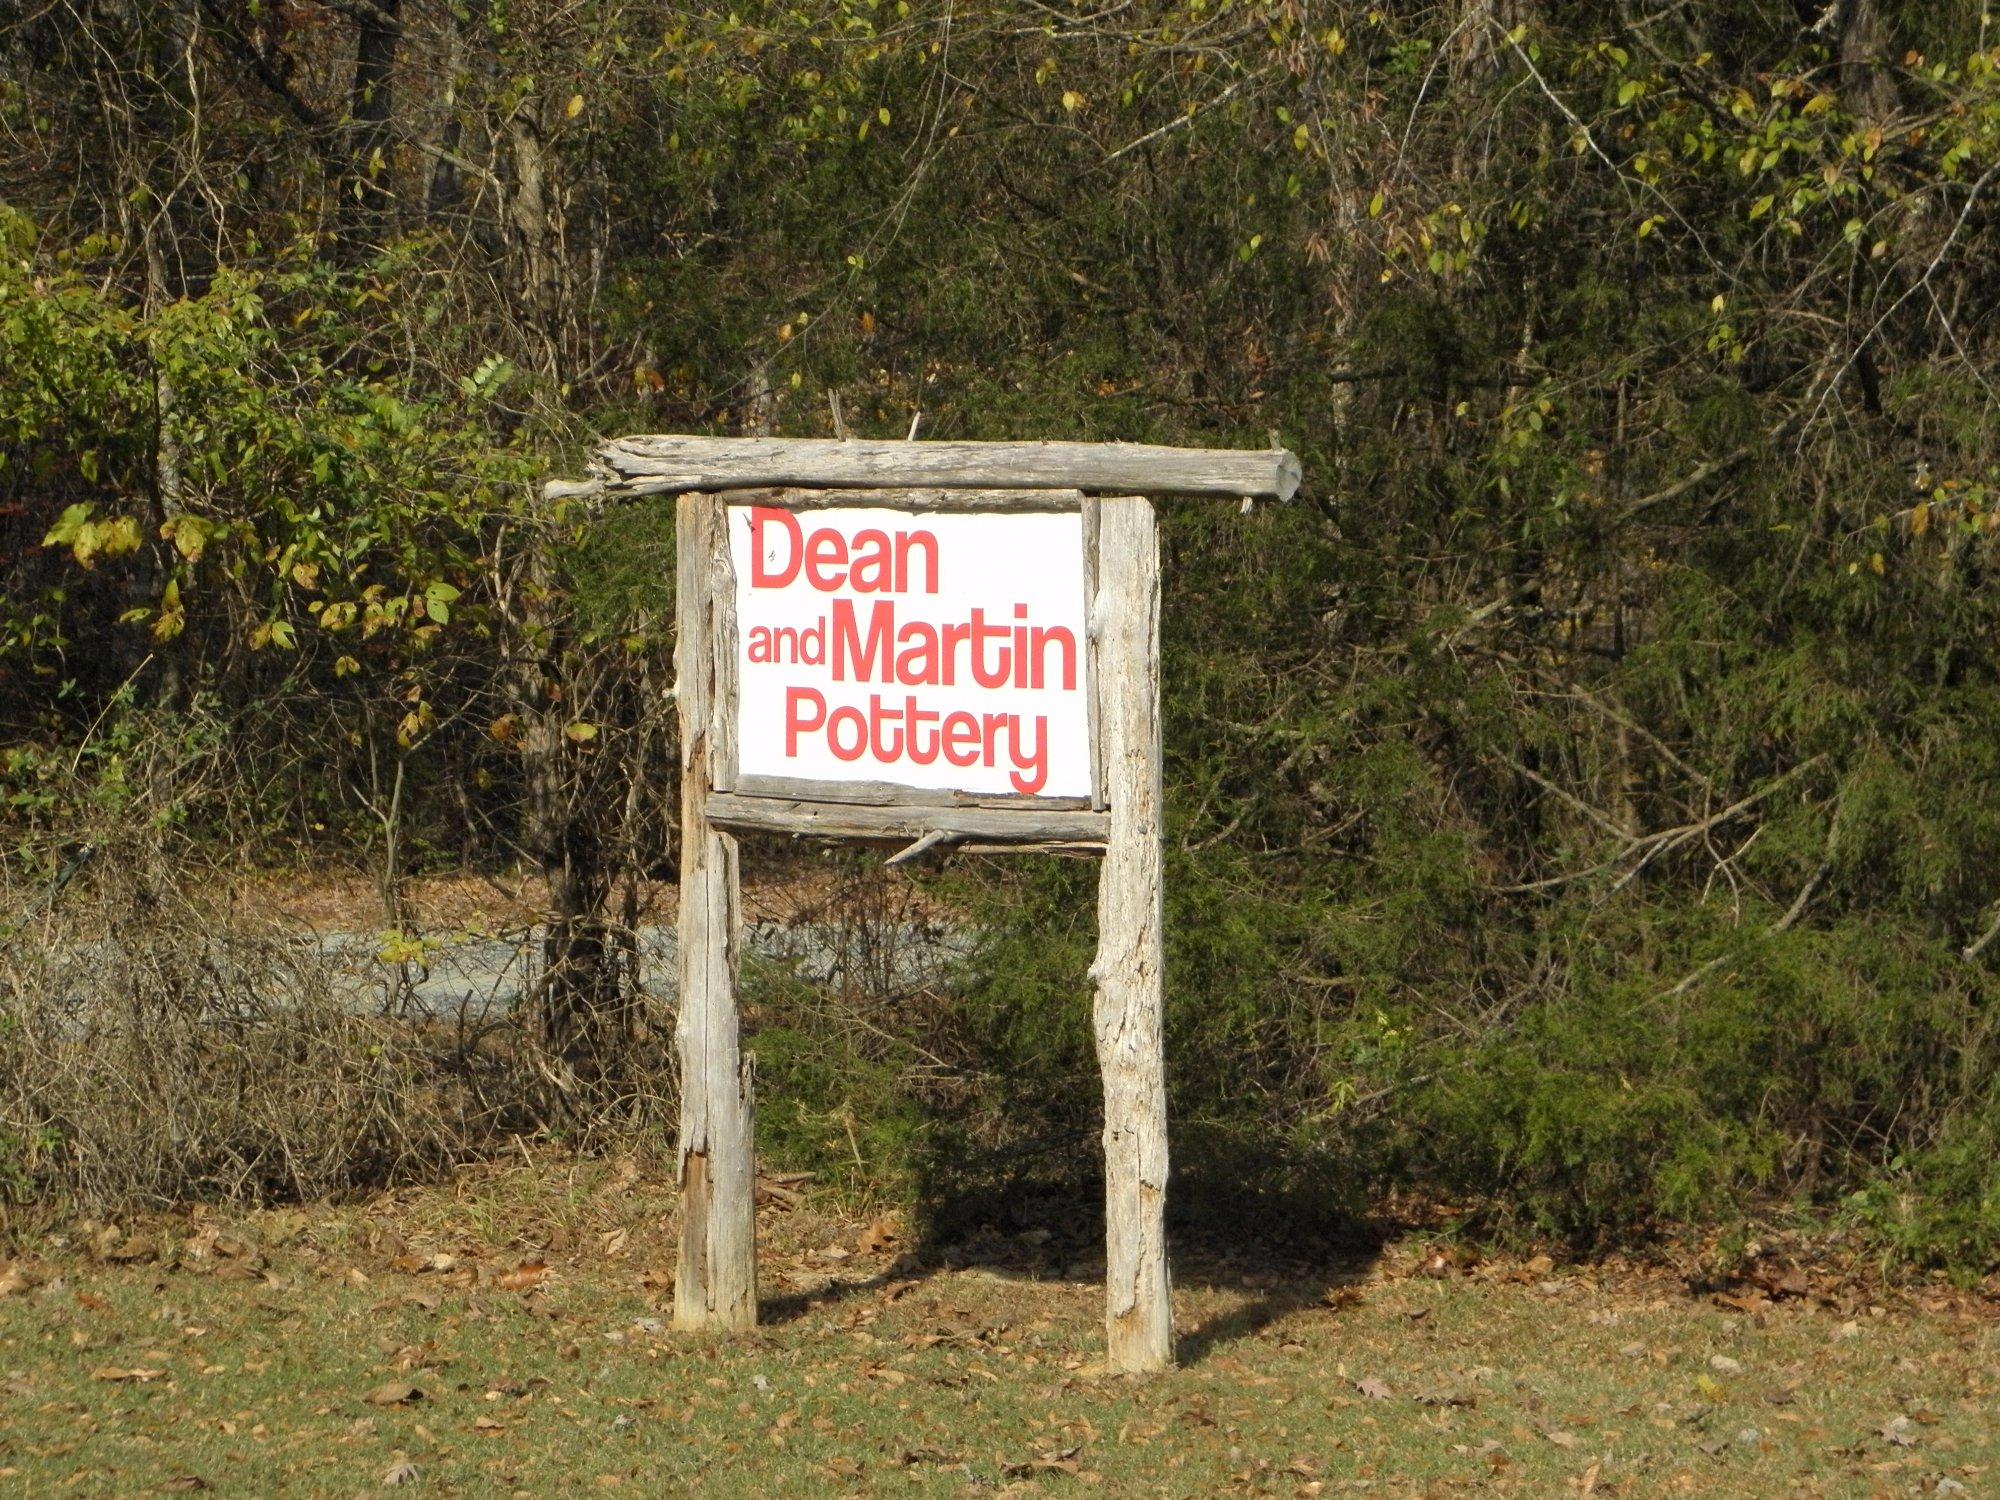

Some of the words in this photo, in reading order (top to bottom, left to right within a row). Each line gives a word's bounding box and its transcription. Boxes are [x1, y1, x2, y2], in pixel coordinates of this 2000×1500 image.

[751, 506, 939, 594] Dean
[747, 616, 826, 666] and
[832, 598, 1077, 691] Martin
[785, 686, 1048, 796] Pottery
